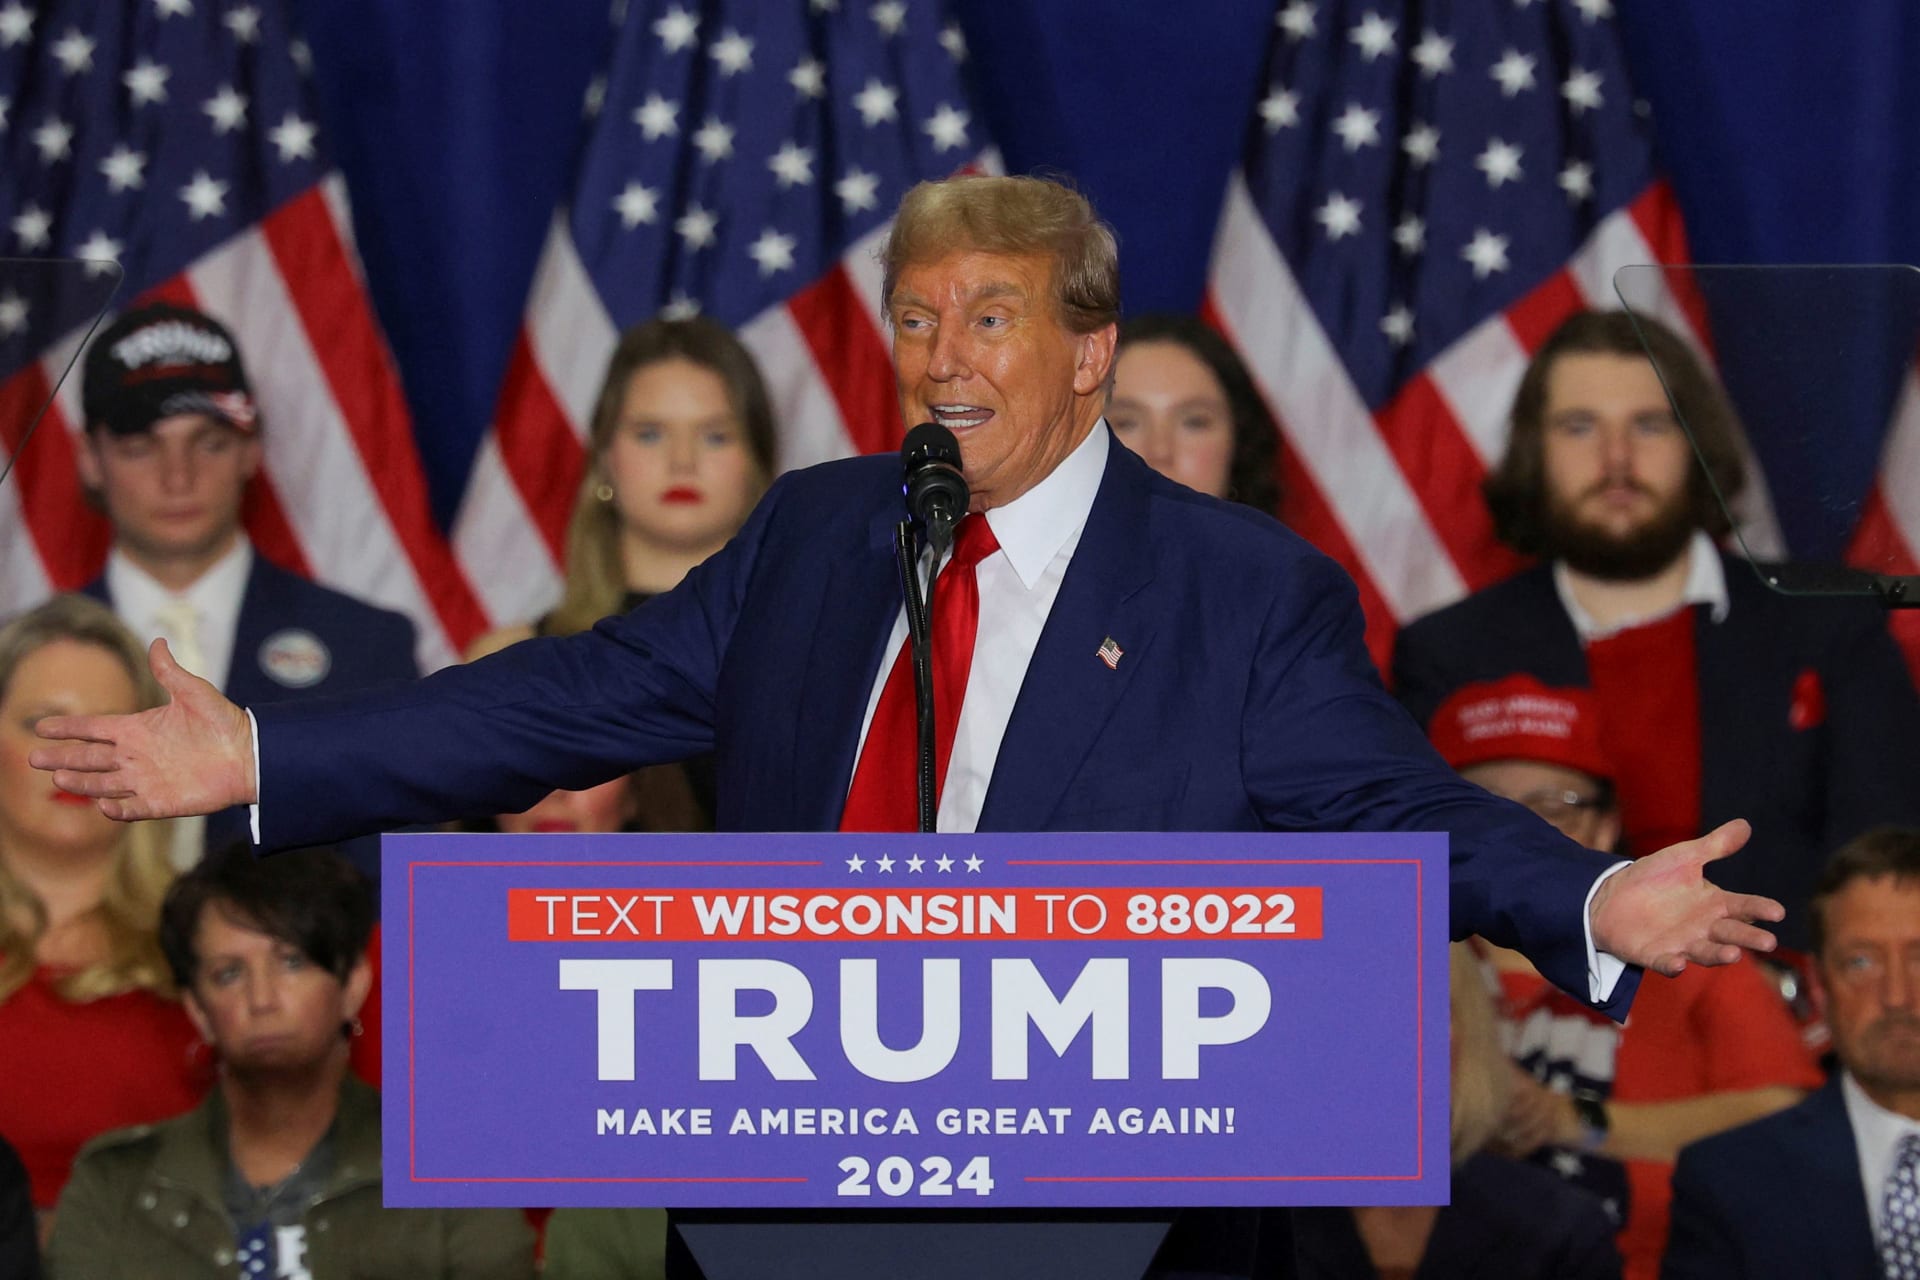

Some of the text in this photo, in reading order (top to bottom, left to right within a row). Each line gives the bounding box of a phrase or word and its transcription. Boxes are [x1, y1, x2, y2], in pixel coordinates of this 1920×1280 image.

[536, 894, 1296, 935] TEXT WISCONSIN TO 88022
[559, 958, 1272, 1083] TRUMP
[596, 1107, 1236, 1135] MAKE AMERICA GREAT AGAIN!
[837, 1156, 995, 1197] 2024
